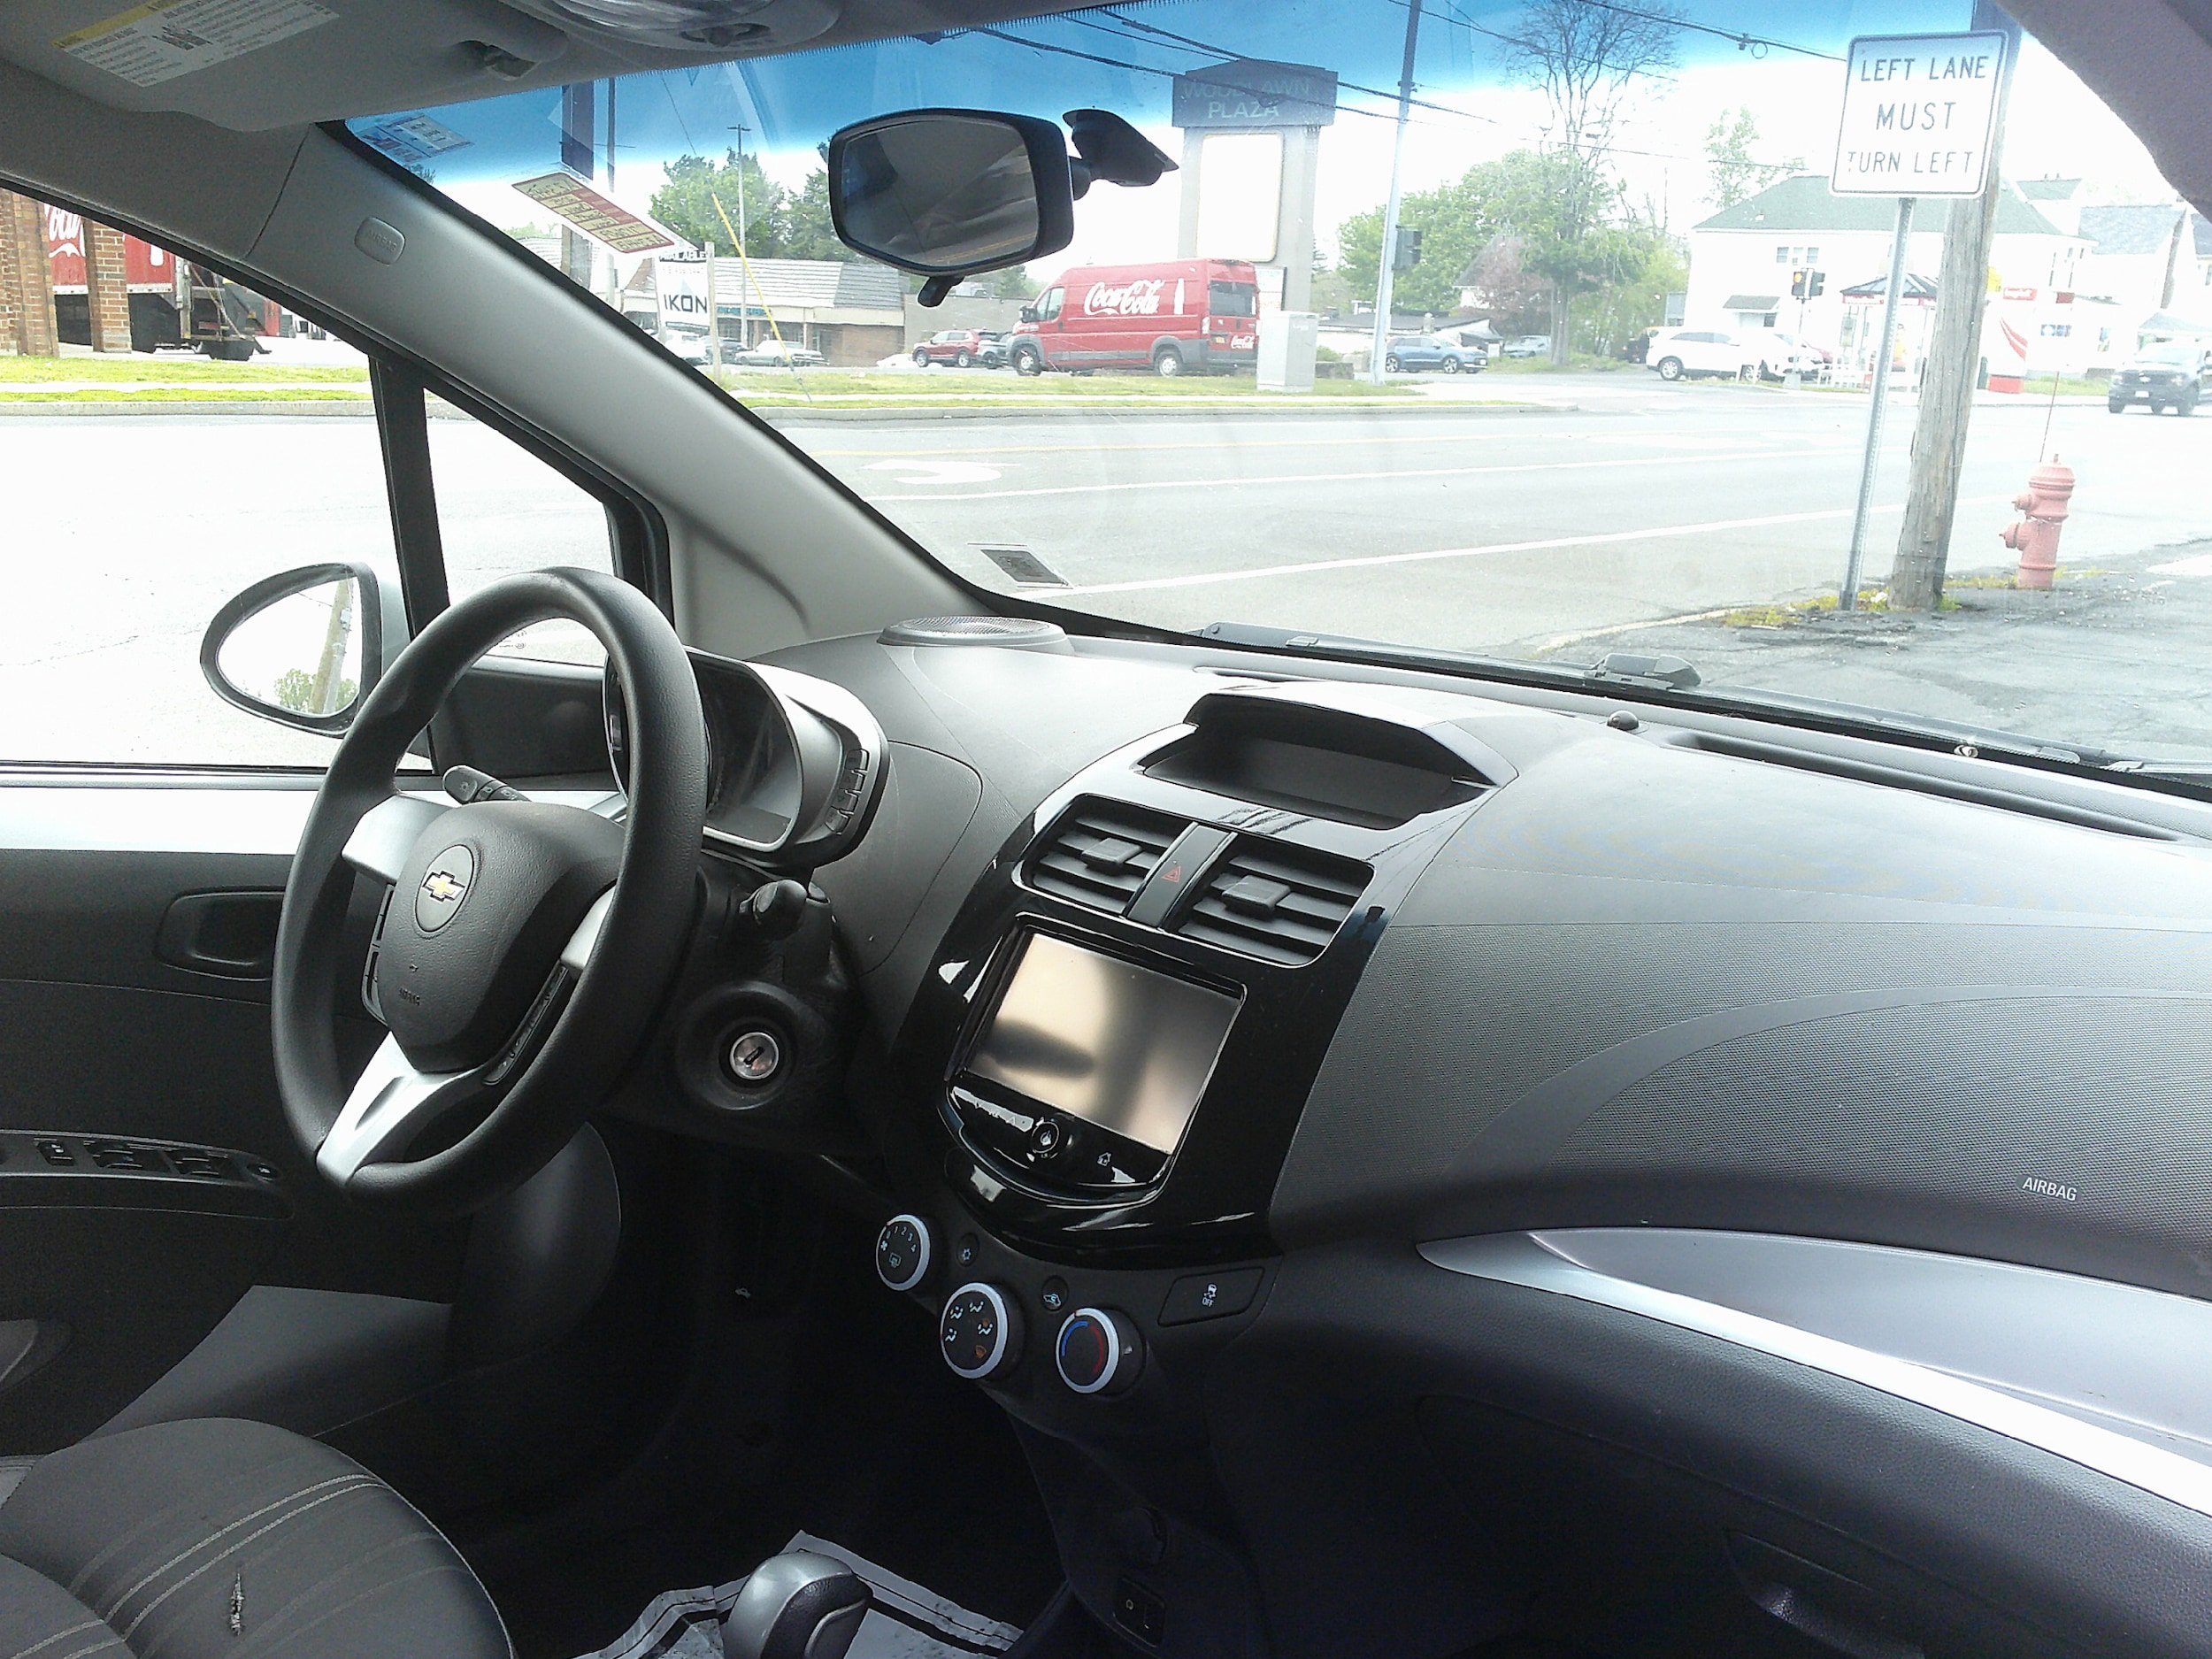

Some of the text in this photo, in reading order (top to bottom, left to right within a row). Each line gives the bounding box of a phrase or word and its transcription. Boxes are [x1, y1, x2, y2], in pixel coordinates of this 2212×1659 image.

[1861, 56, 1989, 81] LEFT LANE
[1209, 101, 1280, 119] PLAZA
[1876, 102, 1956, 131] MUST
[1847, 151, 1973, 173] TURN LEFT
[664, 294, 708, 314] IKON
[2022, 1177, 2078, 1202] AIRBAG
[894, 1225, 899, 1234] 1
[901, 1226, 907, 1236] 2
[908, 1233, 913, 1242] 3
[1202, 1296, 1215, 1308] OFF
